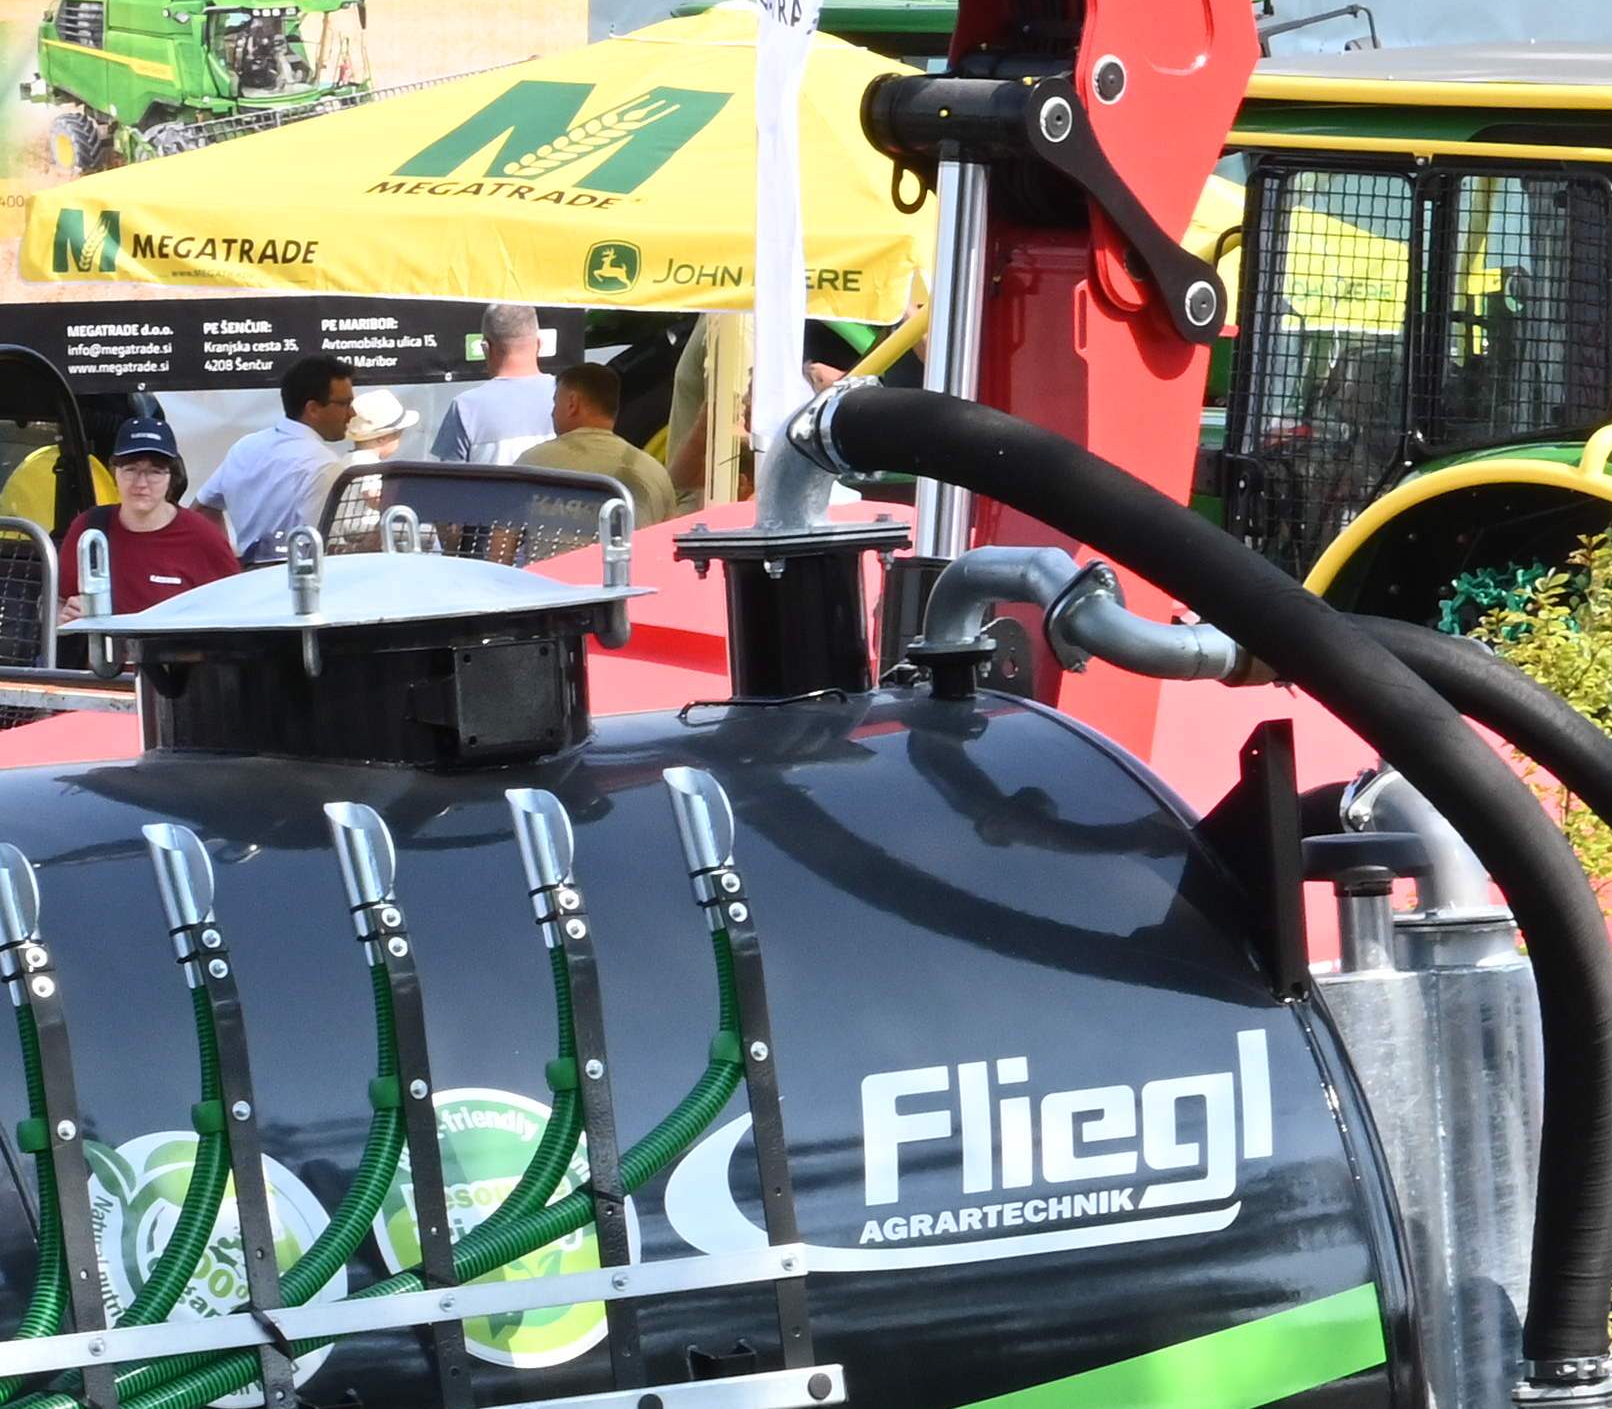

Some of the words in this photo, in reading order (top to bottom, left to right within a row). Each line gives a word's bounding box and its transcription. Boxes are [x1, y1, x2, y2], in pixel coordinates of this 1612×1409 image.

[365, 181, 616, 211] MEGATRADE
[131, 233, 319, 265] MEGATRADE
[653, 257, 743, 288] JOHN
[66, 324, 140, 337] MEGATRADE
[140, 323, 174, 337] d.o.o.
[202, 321, 219, 335] PE
[219, 317, 273, 335] ŠENČUR:
[320, 319, 337, 332] PE
[338, 317, 399, 331] MARIBOR:
[67, 341, 173, 359] info@megatrade.si
[203, 341, 251, 357] Kranjska
[252, 340, 282, 353] cesta
[283, 338, 300, 353] 35,
[320, 336, 395, 351] Avtomobilska
[396, 335, 423, 349] ulica
[67, 361, 170, 376] www.megatrade.si
[203, 359, 233, 372] 4208
[234, 357, 274, 372] Šenčur
[353, 355, 399, 368] Maribor
[436, 1106, 540, 1142] -friendly
[861, 1028, 1274, 1211] Fliegl
[859, 1188, 1135, 1246] AGRARTECHNIK
